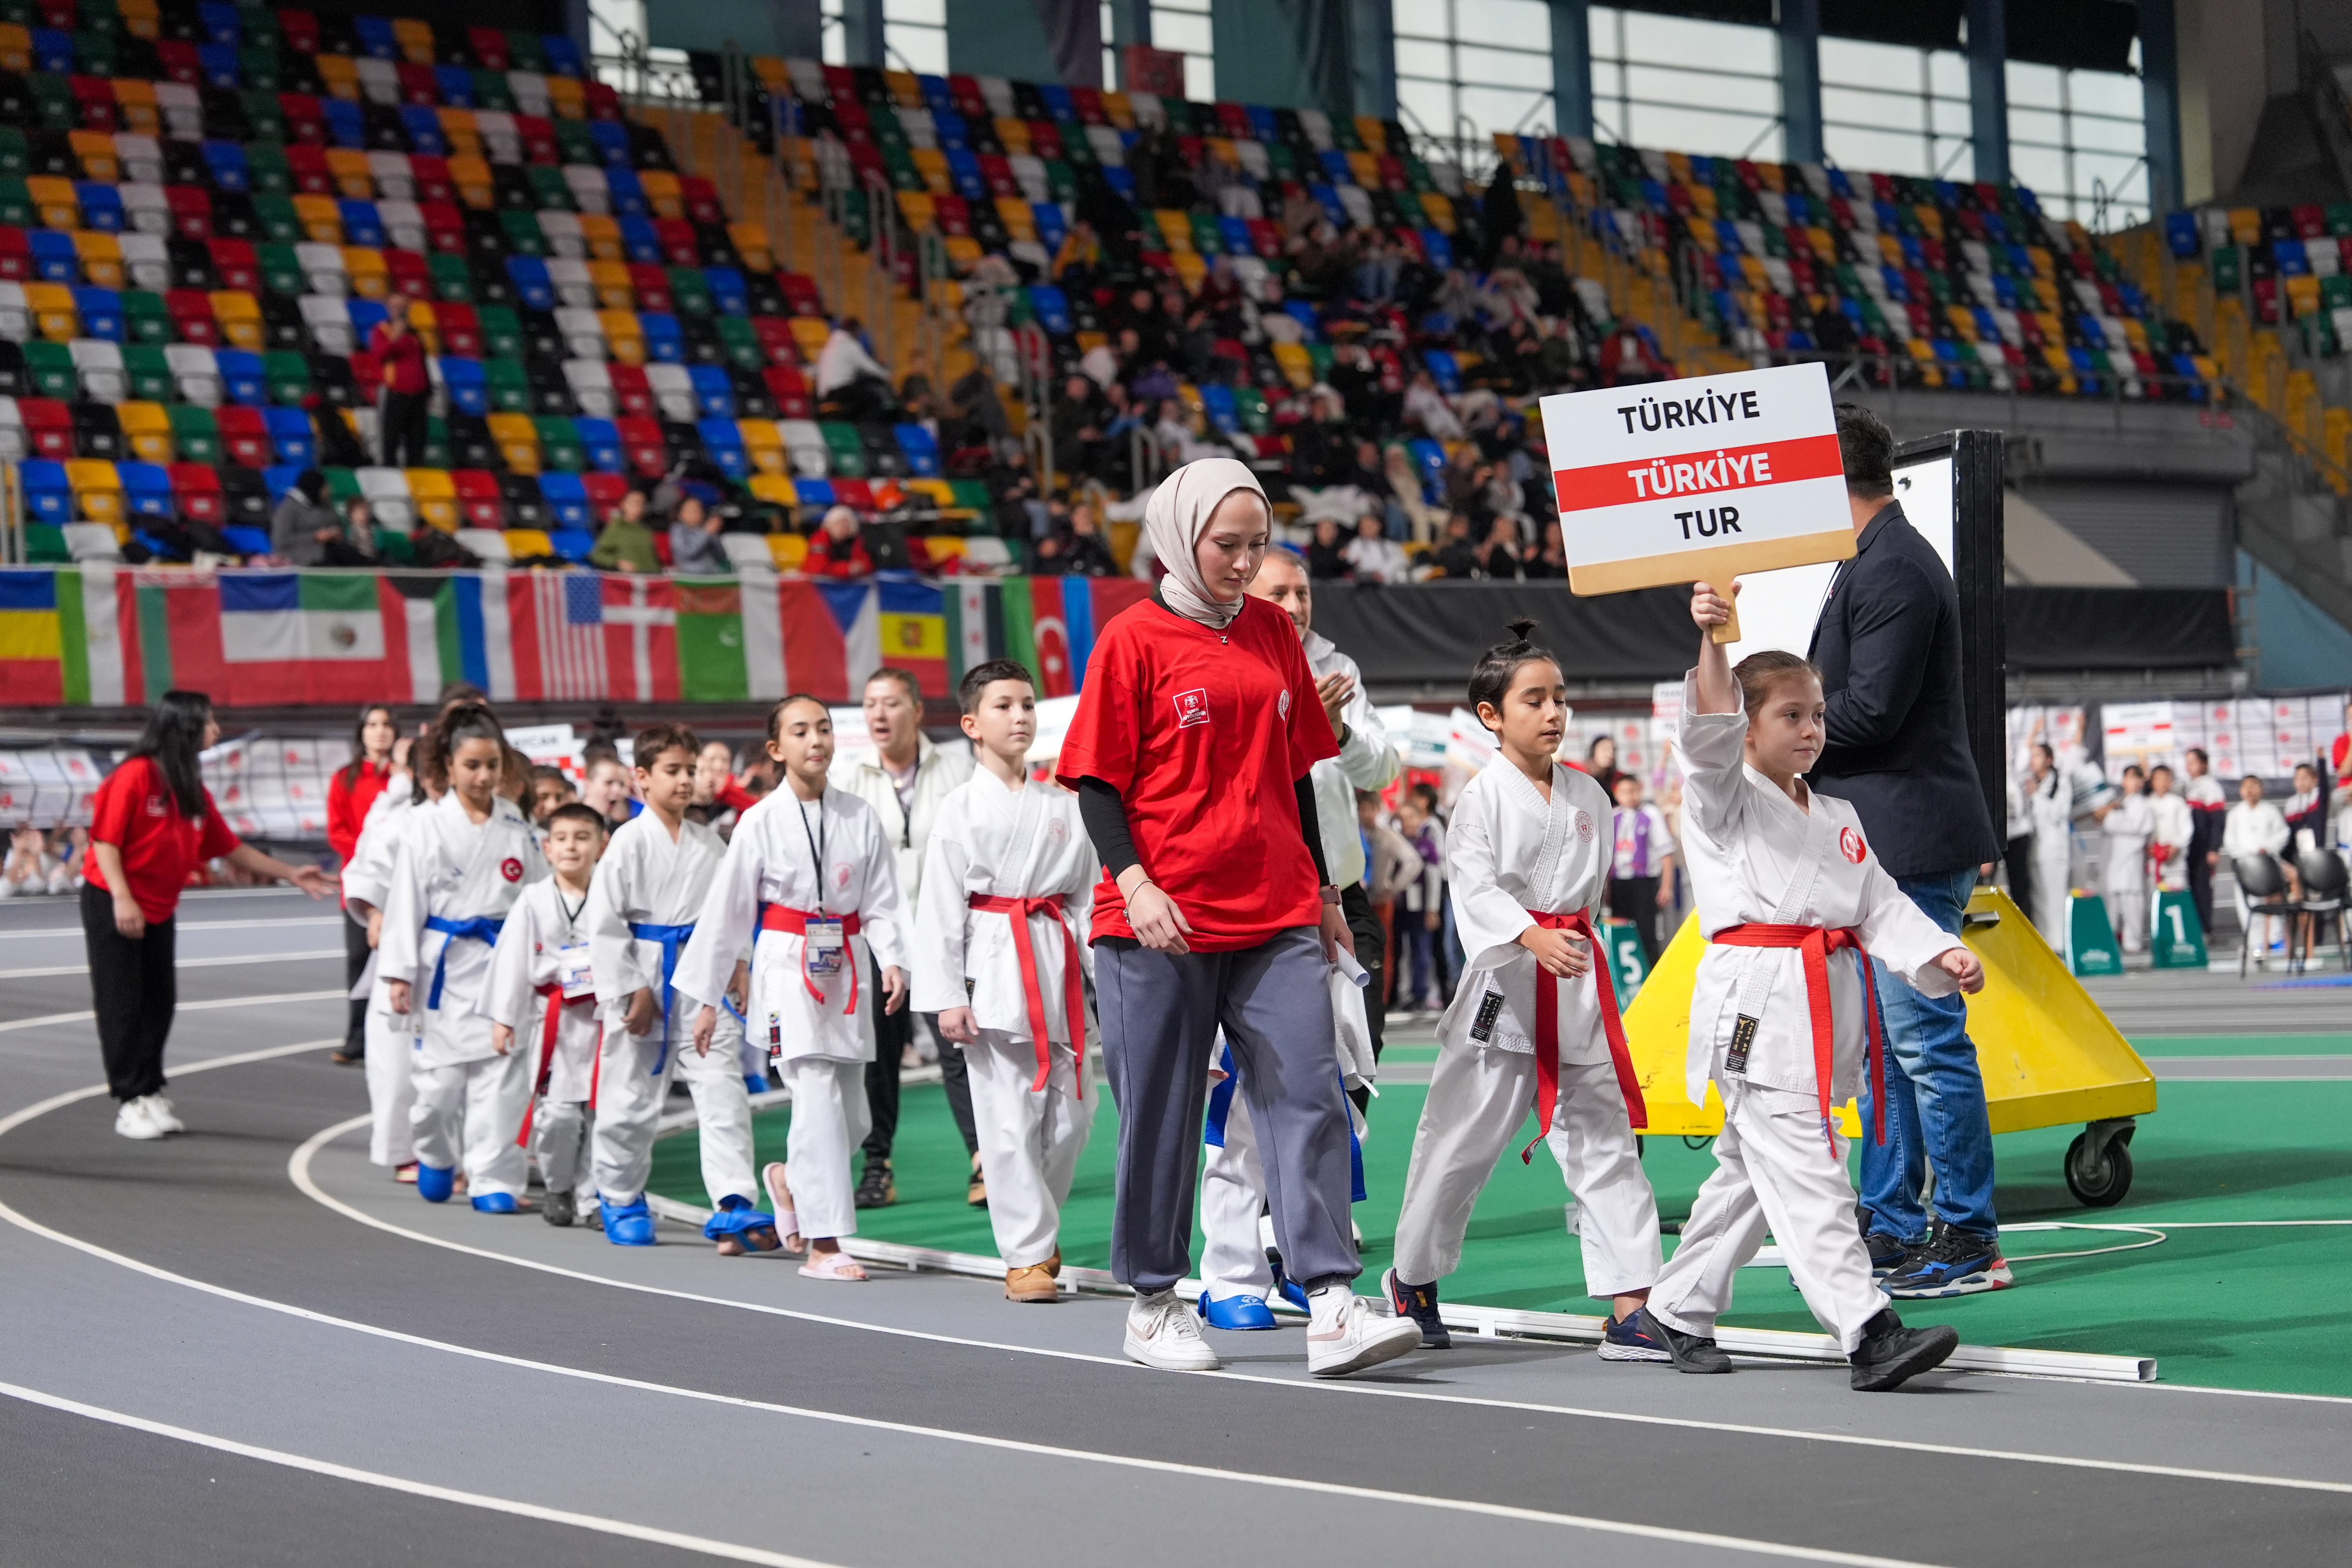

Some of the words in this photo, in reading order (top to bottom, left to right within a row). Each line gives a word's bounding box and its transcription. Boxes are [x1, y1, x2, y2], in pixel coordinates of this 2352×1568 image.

[1617, 388, 1760, 434] TÜRKİYE
[1628, 450, 1772, 497] TÜRKİYE
[1674, 506, 1742, 539] TUR
[2164, 904, 2186, 942] 1
[1618, 940, 1643, 985] 5
